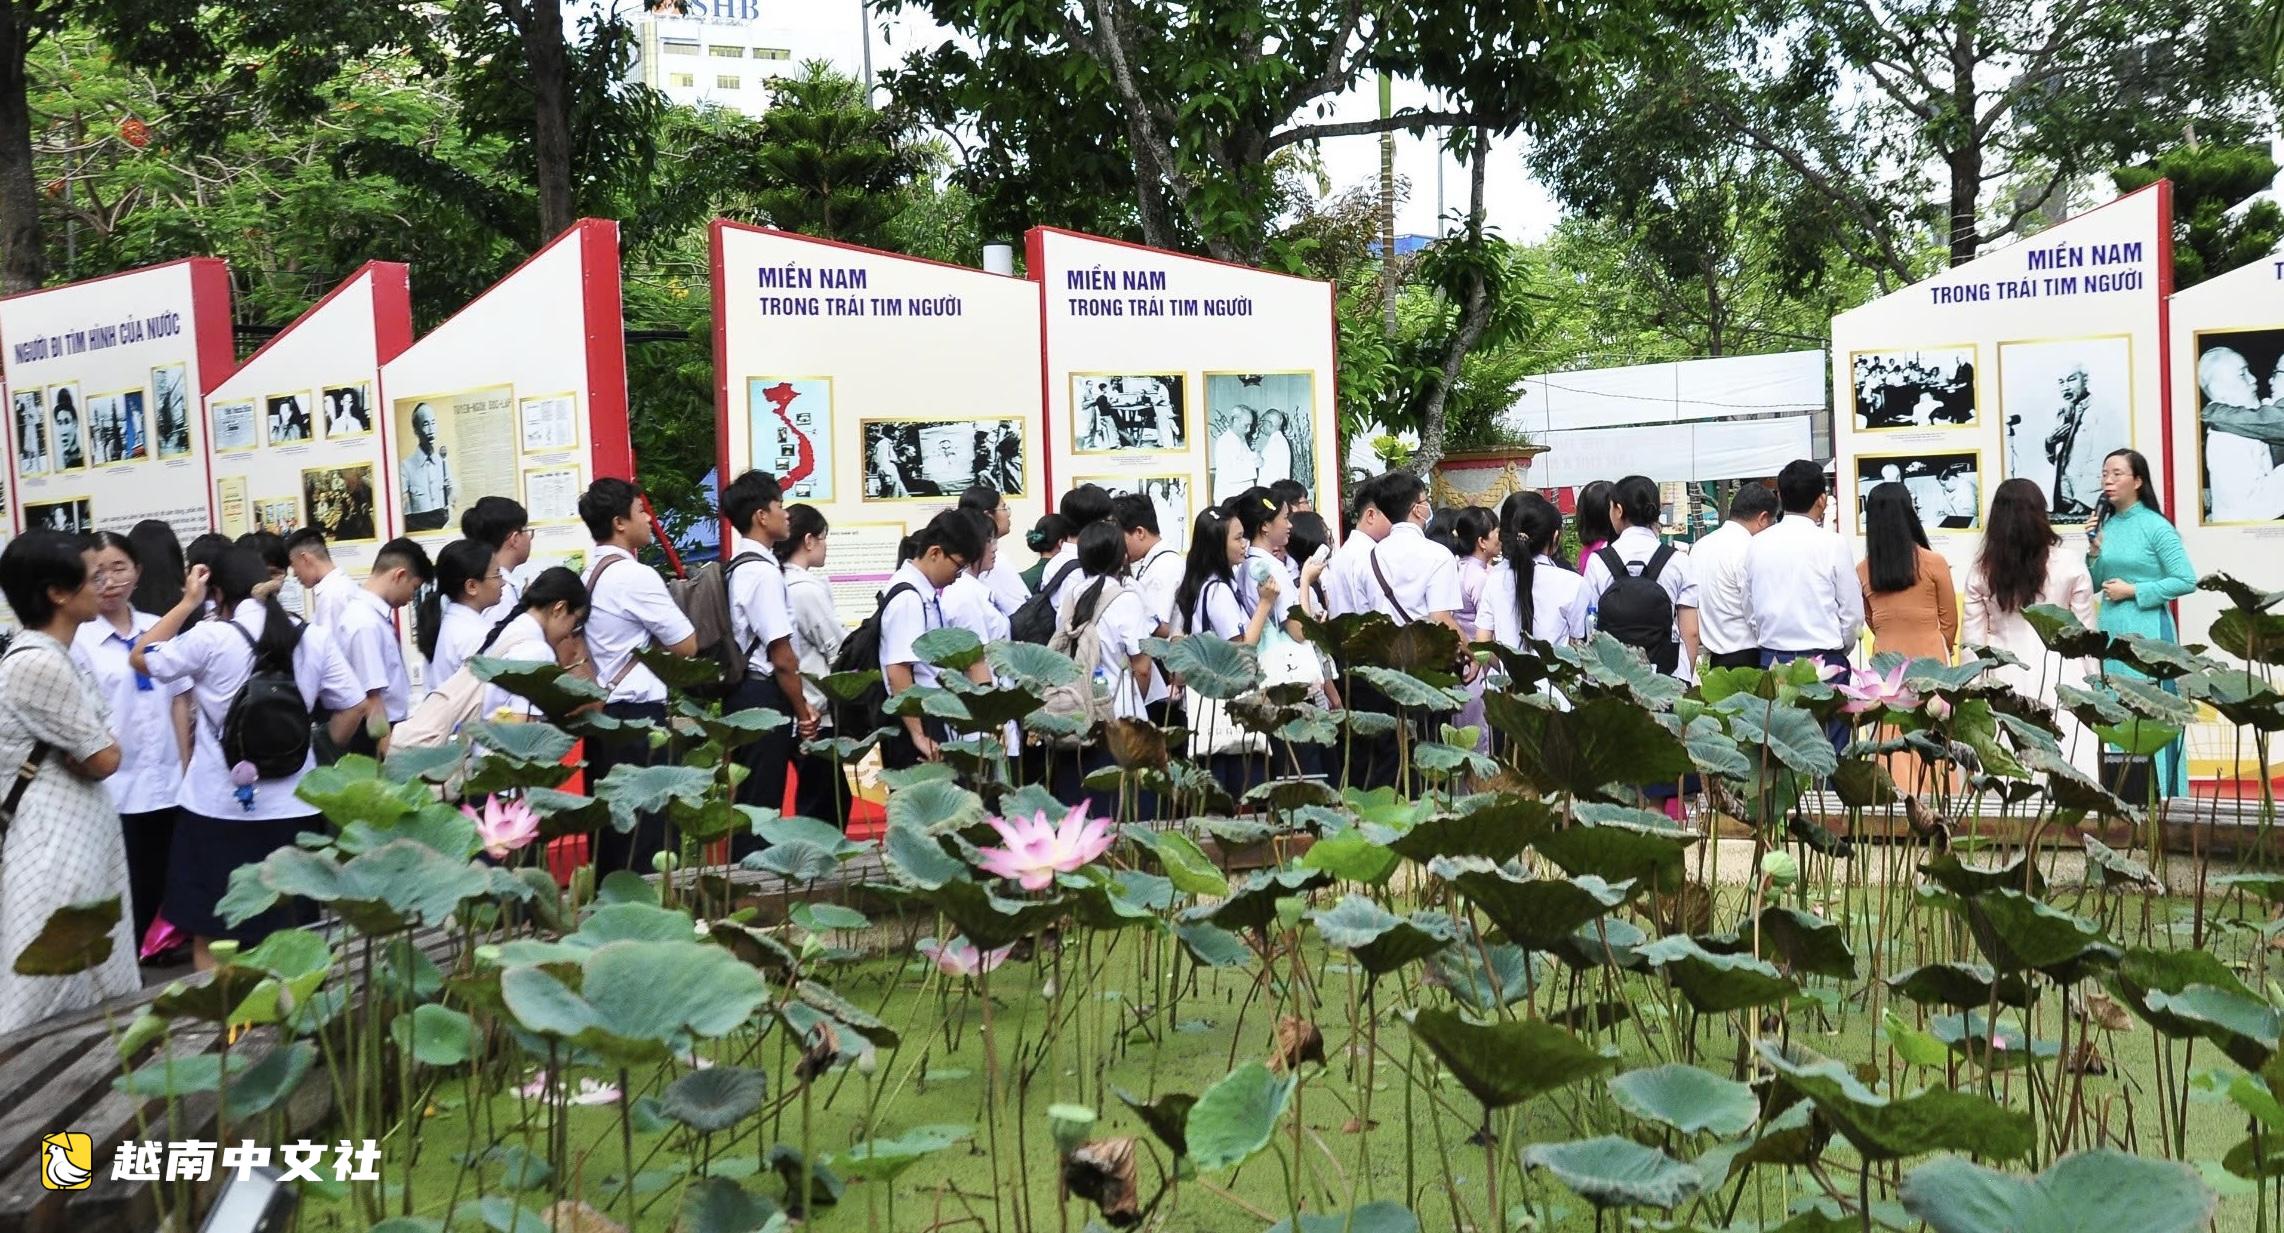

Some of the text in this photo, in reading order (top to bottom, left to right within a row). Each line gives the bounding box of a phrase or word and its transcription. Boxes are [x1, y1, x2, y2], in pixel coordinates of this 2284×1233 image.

[687, 0, 759, 19] SHB
[2028, 241, 2142, 271] MIỀN NAM
[758, 260, 867, 290] MIỀN NAM
[1067, 263, 1166, 291] MIỀN NAM
[1931, 268, 2142, 304] TRONG TRÁI TIM NGƯỜI
[760, 294, 962, 317] TRONG TRÁI TIM NGƯỜI
[1068, 295, 1253, 317] TRONG TRÁI TIM NGƯỜI
